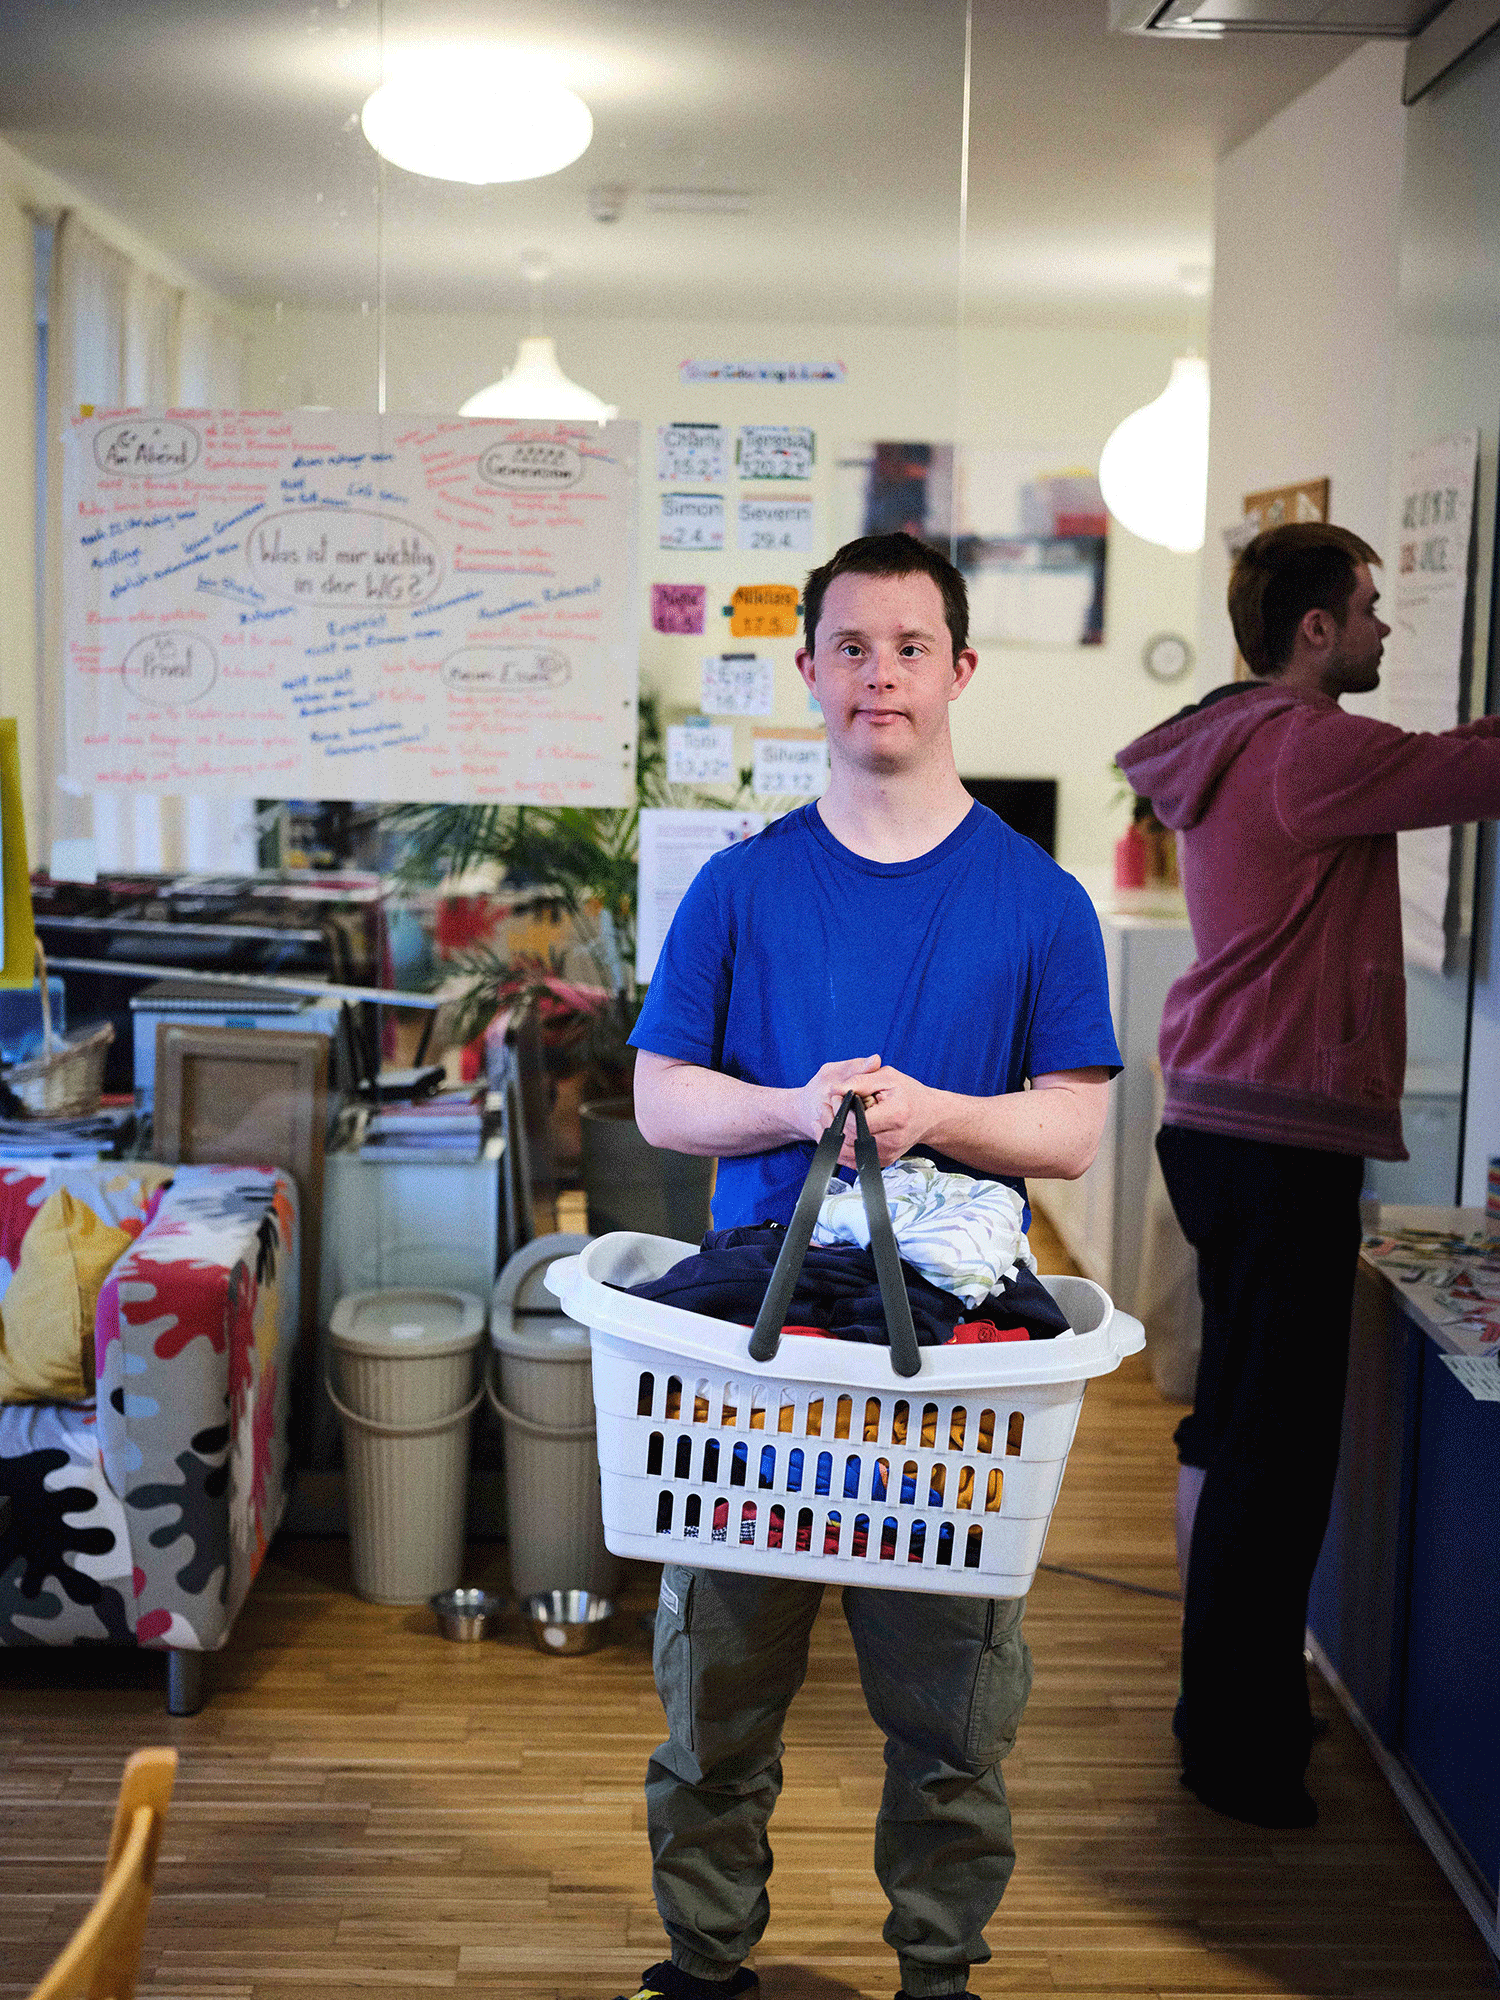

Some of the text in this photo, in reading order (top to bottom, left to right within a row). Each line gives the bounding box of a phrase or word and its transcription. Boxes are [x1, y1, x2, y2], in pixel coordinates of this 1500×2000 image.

[135, 440, 188, 465] Abend
[663, 501, 723, 518] Simon
[739, 502, 812, 522] Severin
[258, 527, 299, 565] Was
[306, 532, 327, 565] ist
[334, 547, 369, 565] mir
[373, 536, 437, 577] wichtig
[293, 576, 315, 595] in
[320, 573, 358, 595] der
